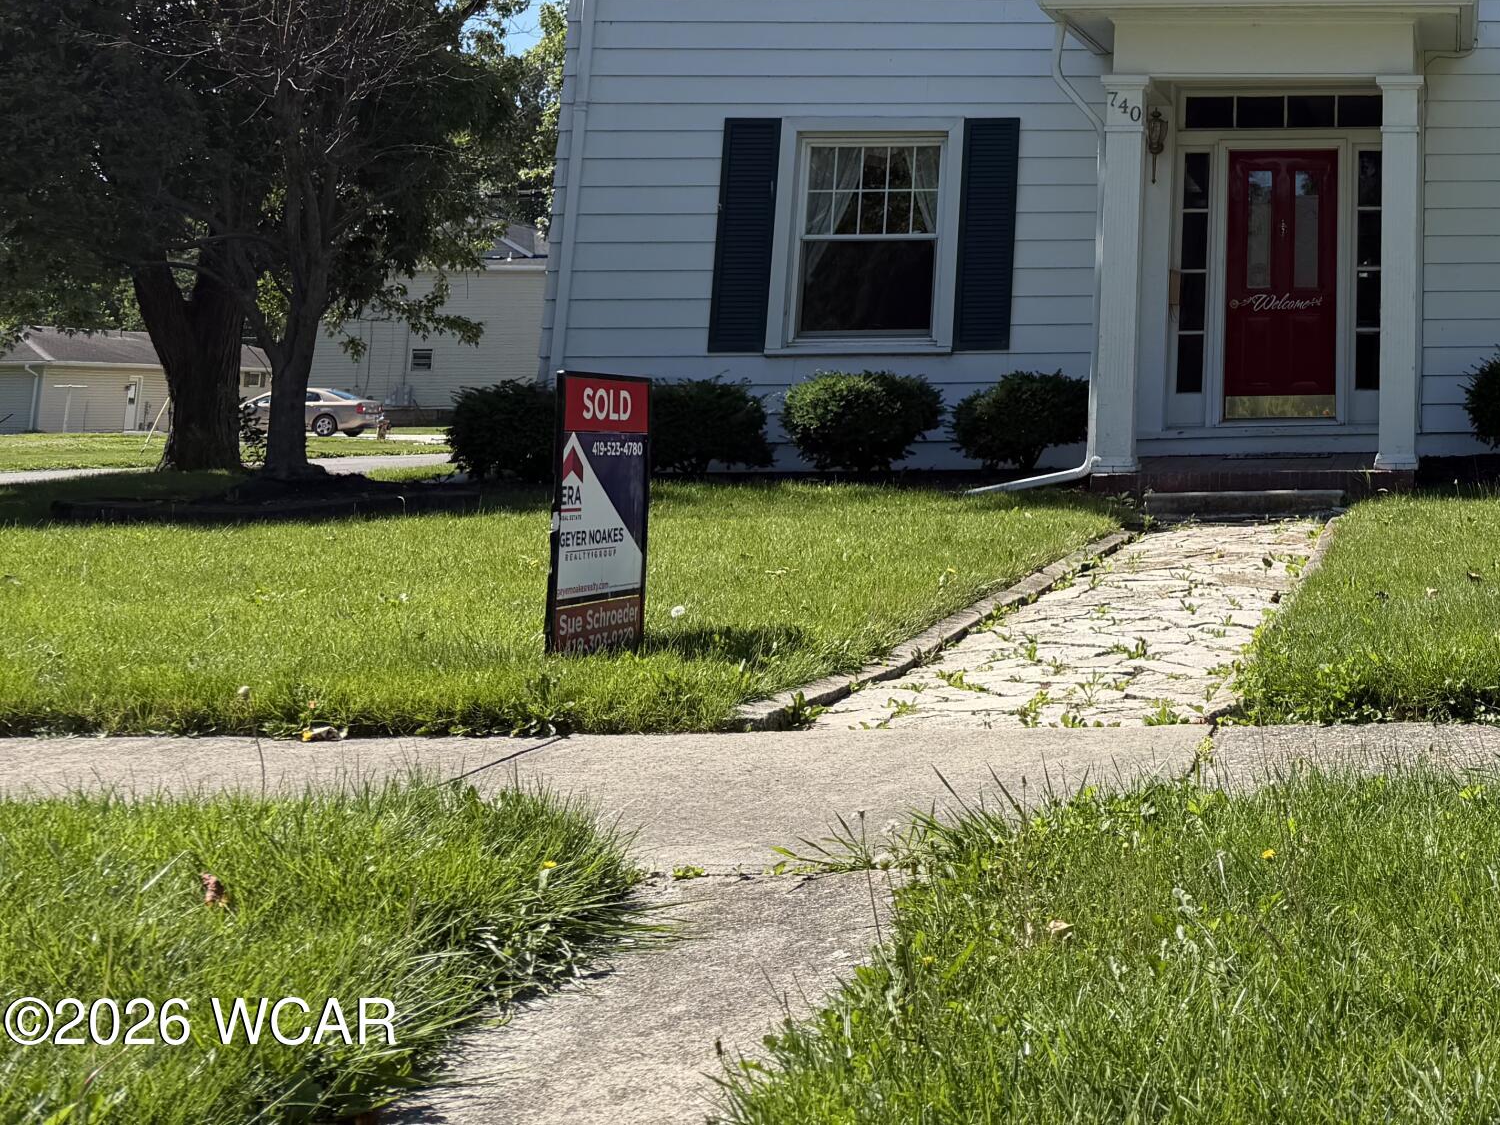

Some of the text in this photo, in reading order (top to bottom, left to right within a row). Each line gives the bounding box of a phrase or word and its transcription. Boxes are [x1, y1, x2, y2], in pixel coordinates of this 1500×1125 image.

[1107, 92, 1142, 122] 740
[1253, 293, 1310, 312] Welcome
[582, 387, 632, 421] SOLD
[592, 441, 643, 456] 419-523-4780
[561, 485, 582, 506] ERA
[560, 527, 624, 548] GEYER NOAKES
[559, 602, 639, 636] Sue Schroeder
